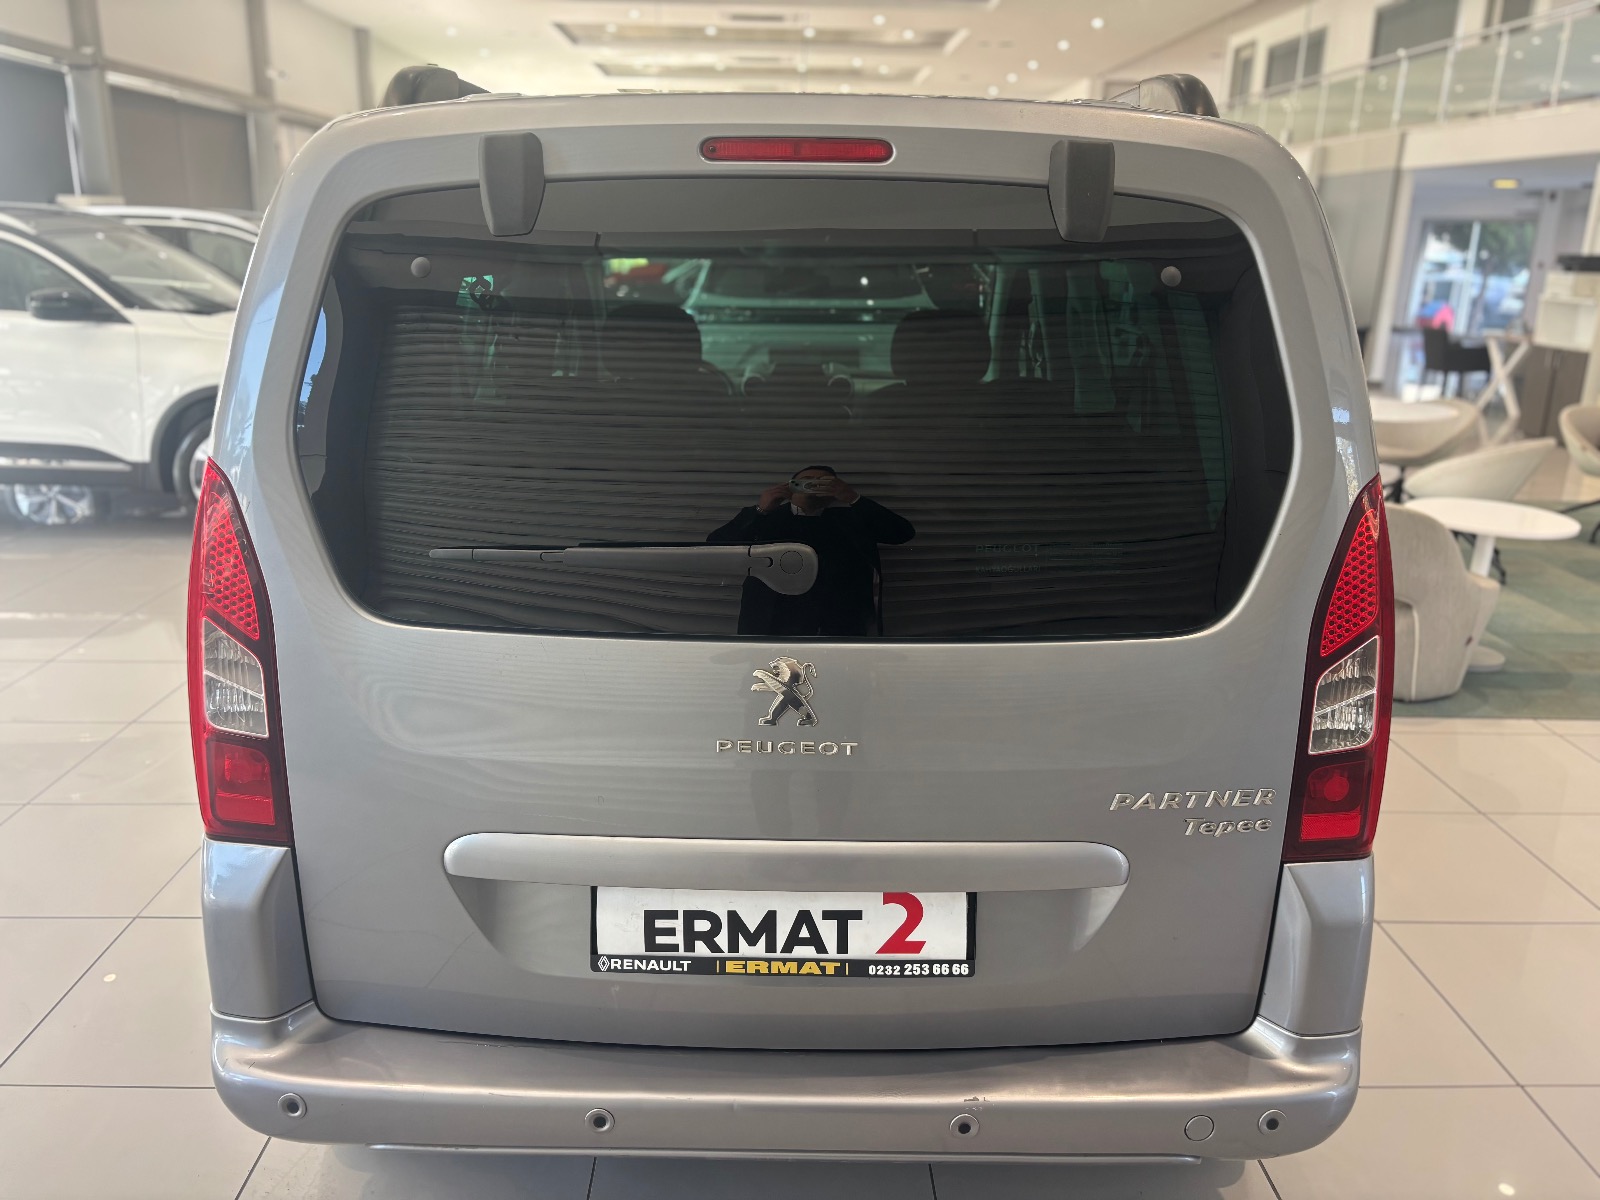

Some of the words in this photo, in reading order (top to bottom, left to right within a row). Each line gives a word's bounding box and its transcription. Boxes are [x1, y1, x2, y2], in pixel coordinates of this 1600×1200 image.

[715, 739, 859, 756] PEUGEOT
[1108, 788, 1277, 811] PARTNER
[1183, 817, 1273, 838] Tepee
[643, 909, 863, 955] ERMAT
[875, 892, 927, 955] 2
[610, 959, 692, 972] RENAULT
[725, 961, 841, 975] ERMAT
[868, 964, 901, 975] 0232
[904, 963, 930, 976] 253
[932, 964, 950, 976] 66
[951, 964, 969, 976] 66
